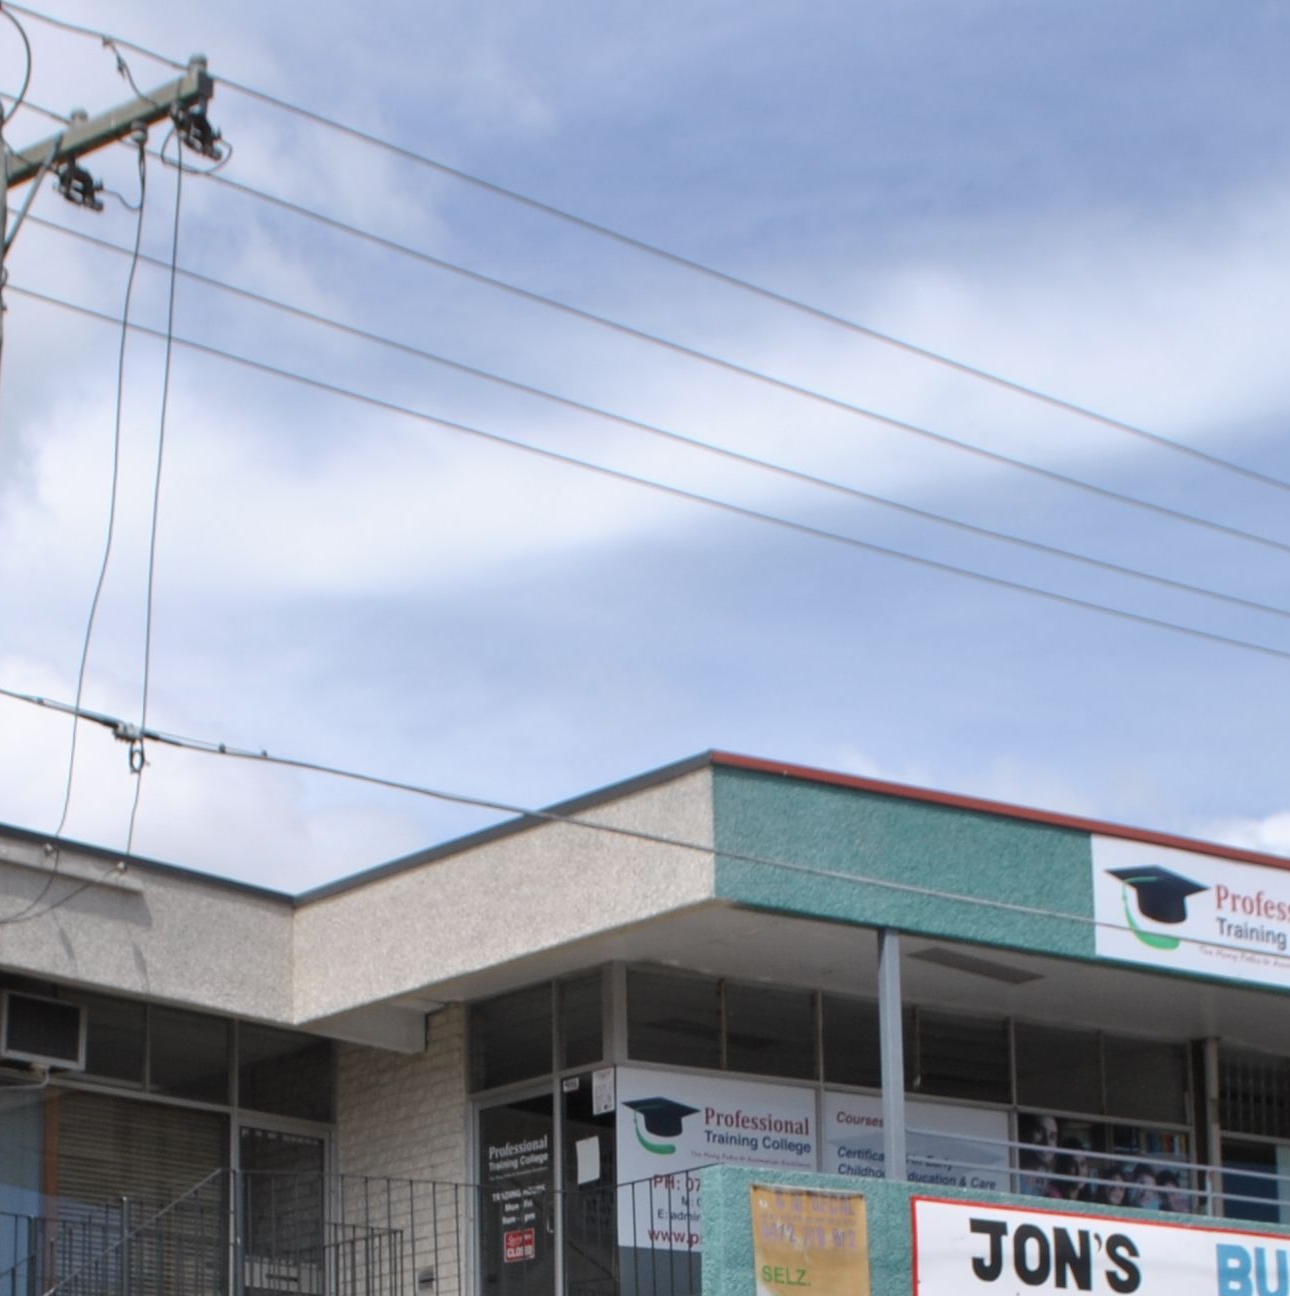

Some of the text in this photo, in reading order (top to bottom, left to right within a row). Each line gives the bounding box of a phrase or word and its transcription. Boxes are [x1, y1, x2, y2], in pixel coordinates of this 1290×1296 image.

[1216, 917, 1287, 951] Training
[705, 1107, 809, 1136] Professional
[837, 1111, 884, 1128] Courses
[489, 1134, 547, 1160] Professional
[704, 1130, 811, 1155] Training College
[489, 1153, 548, 1172] Training College
[838, 1146, 885, 1162] Certifica
[907, 1171, 956, 1187] ducation
[970, 1176, 996, 1190] Care
[648, 1230, 702, 1248] www.p
[969, 1217, 1142, 1294] JON'S
